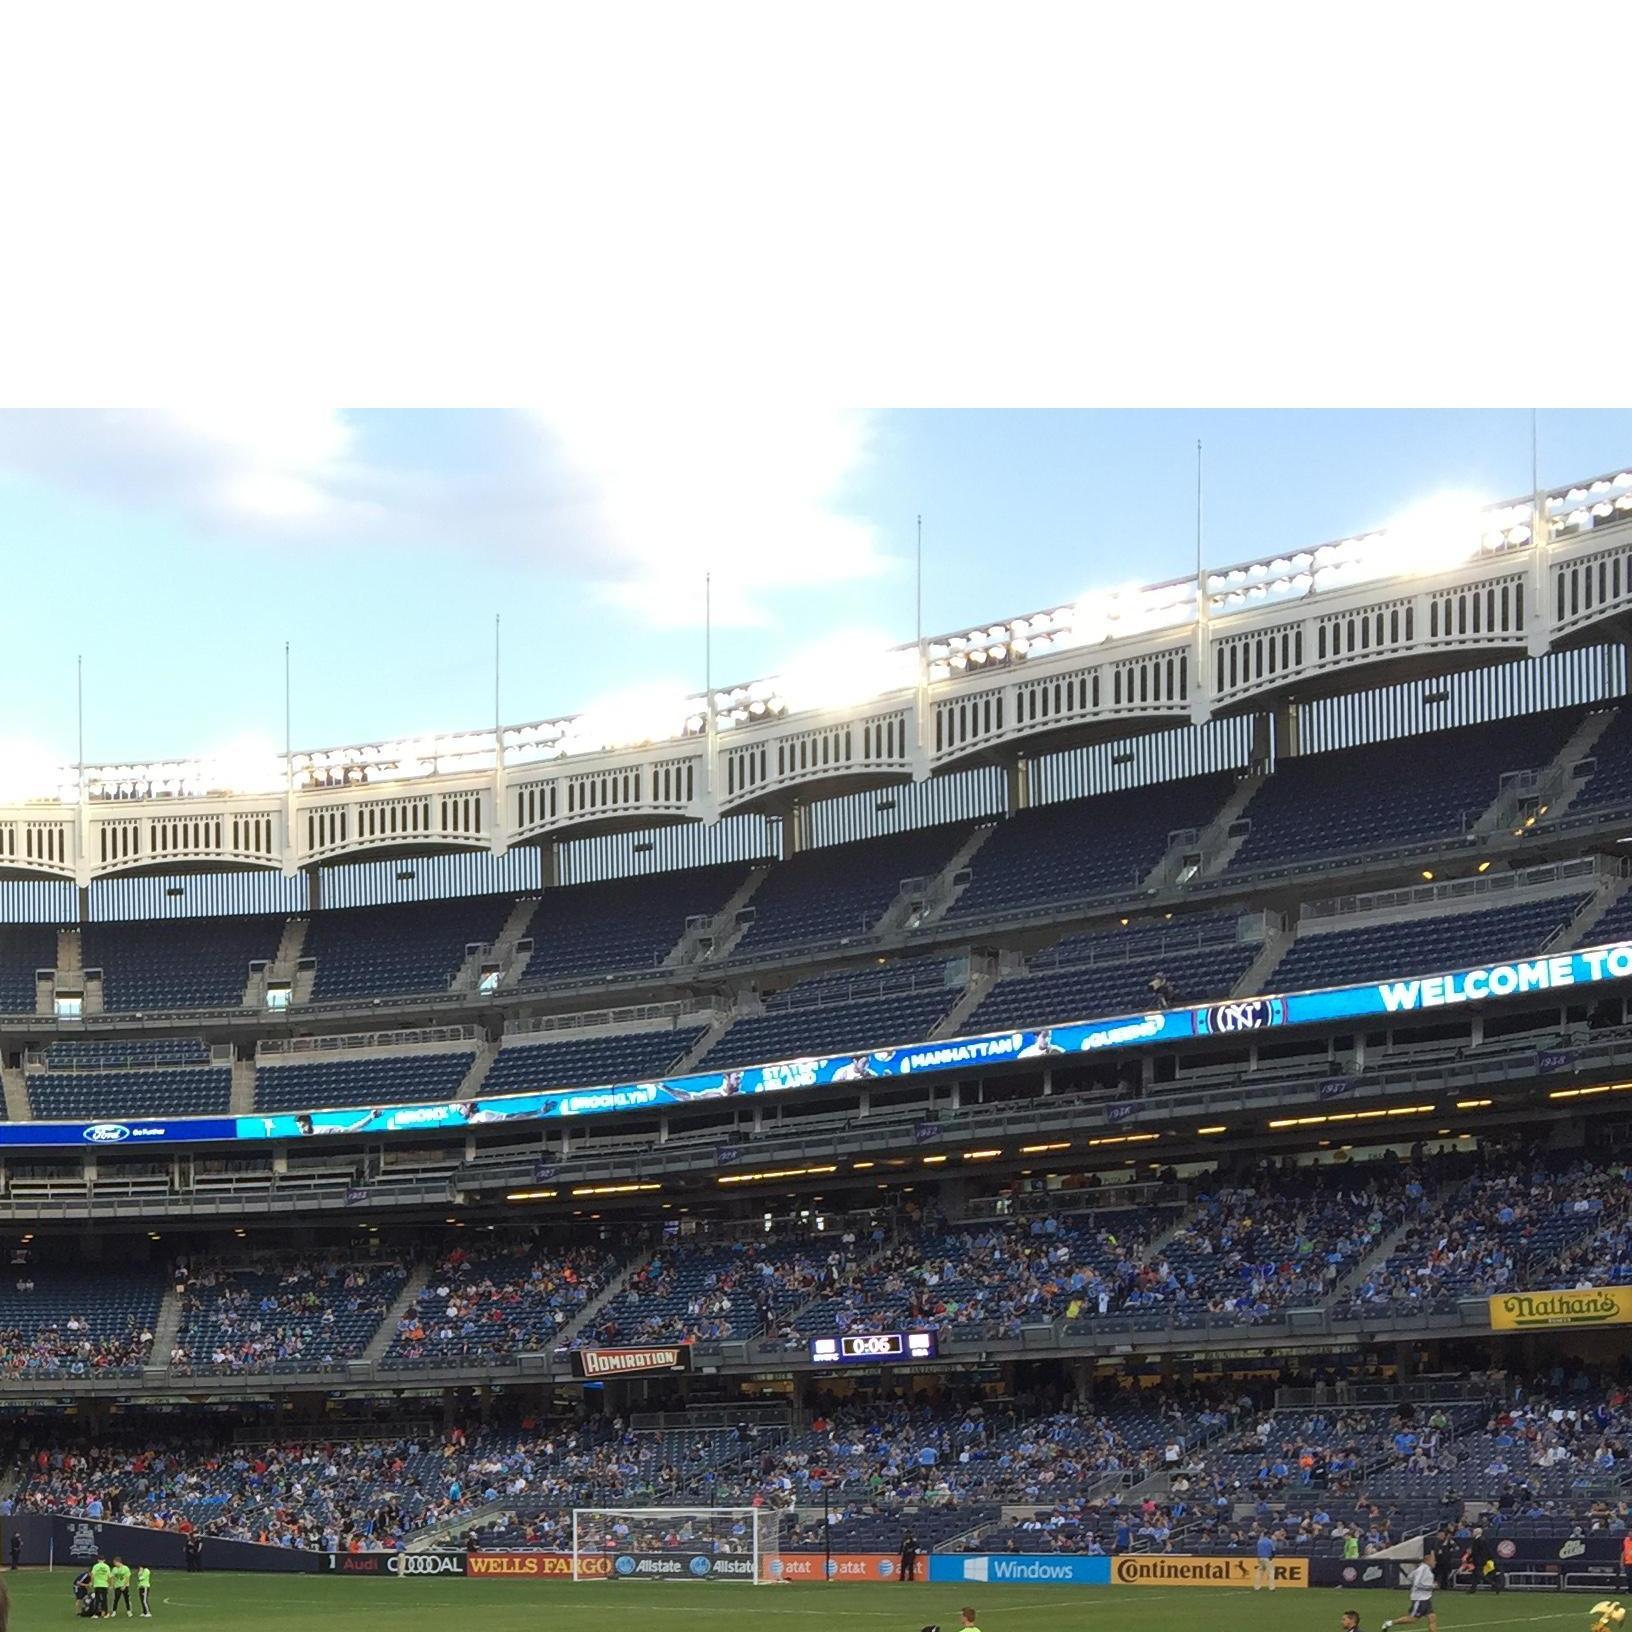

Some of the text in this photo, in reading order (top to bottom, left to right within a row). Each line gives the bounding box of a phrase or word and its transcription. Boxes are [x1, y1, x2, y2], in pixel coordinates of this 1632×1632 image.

[1378, 946, 1632, 1011] WELCOME TO
[911, 1039, 1013, 1068] MANHATTAN
[1504, 1291, 1617, 1317] Nathan's
[585, 1351, 674, 1373] ADMIRATION
[344, 1557, 379, 1570] Audi
[470, 1557, 613, 1575] WELLS FARGO
[636, 1559, 682, 1574] Allstate
[786, 1560, 812, 1574] at&t
[839, 1560, 866, 1574] at&t
[994, 1560, 1073, 1579] Windows
[1118, 1558, 1230, 1583] Continental
